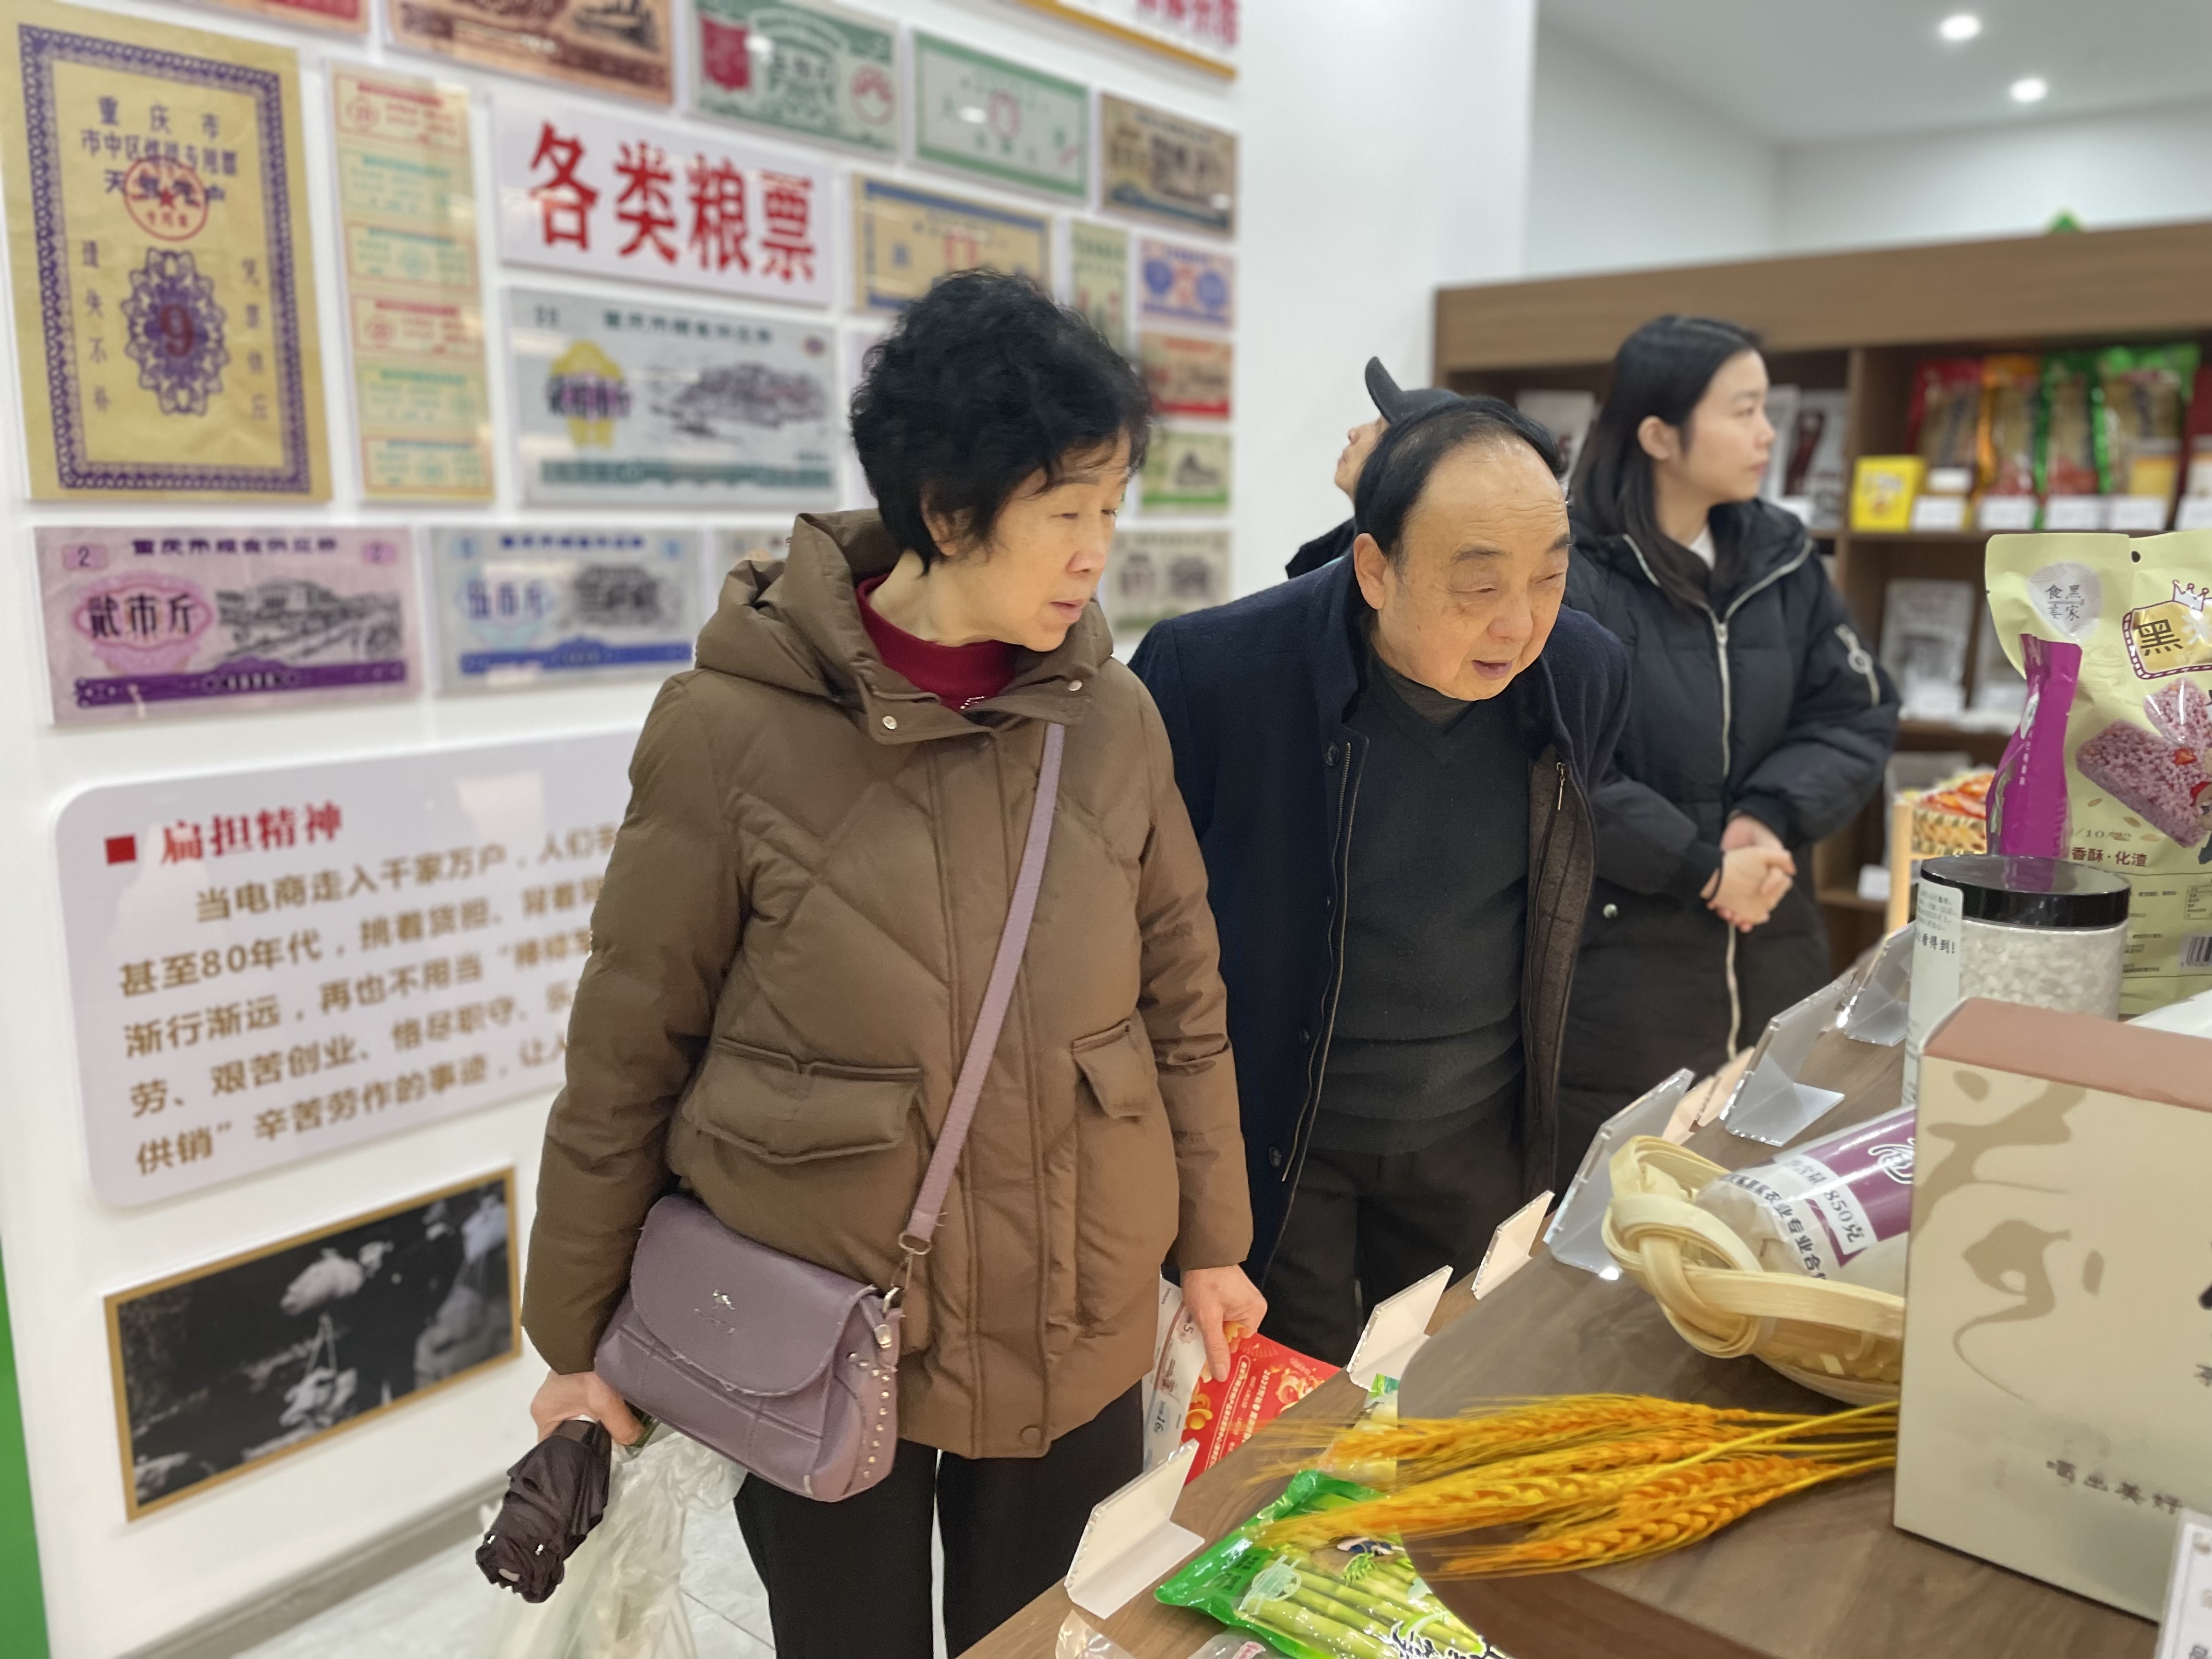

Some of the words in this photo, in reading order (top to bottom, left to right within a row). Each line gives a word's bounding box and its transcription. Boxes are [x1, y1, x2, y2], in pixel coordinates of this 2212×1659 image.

[97, 94, 219, 140] 重庆市
[528, 120, 816, 284] 各类粮票
[77, 546, 91, 567] 2
[160, 799, 341, 865] 扁担精神
[2072, 847, 2147, 867] 香酥·化渣
[1822, 1189, 1865, 1244] 850克
